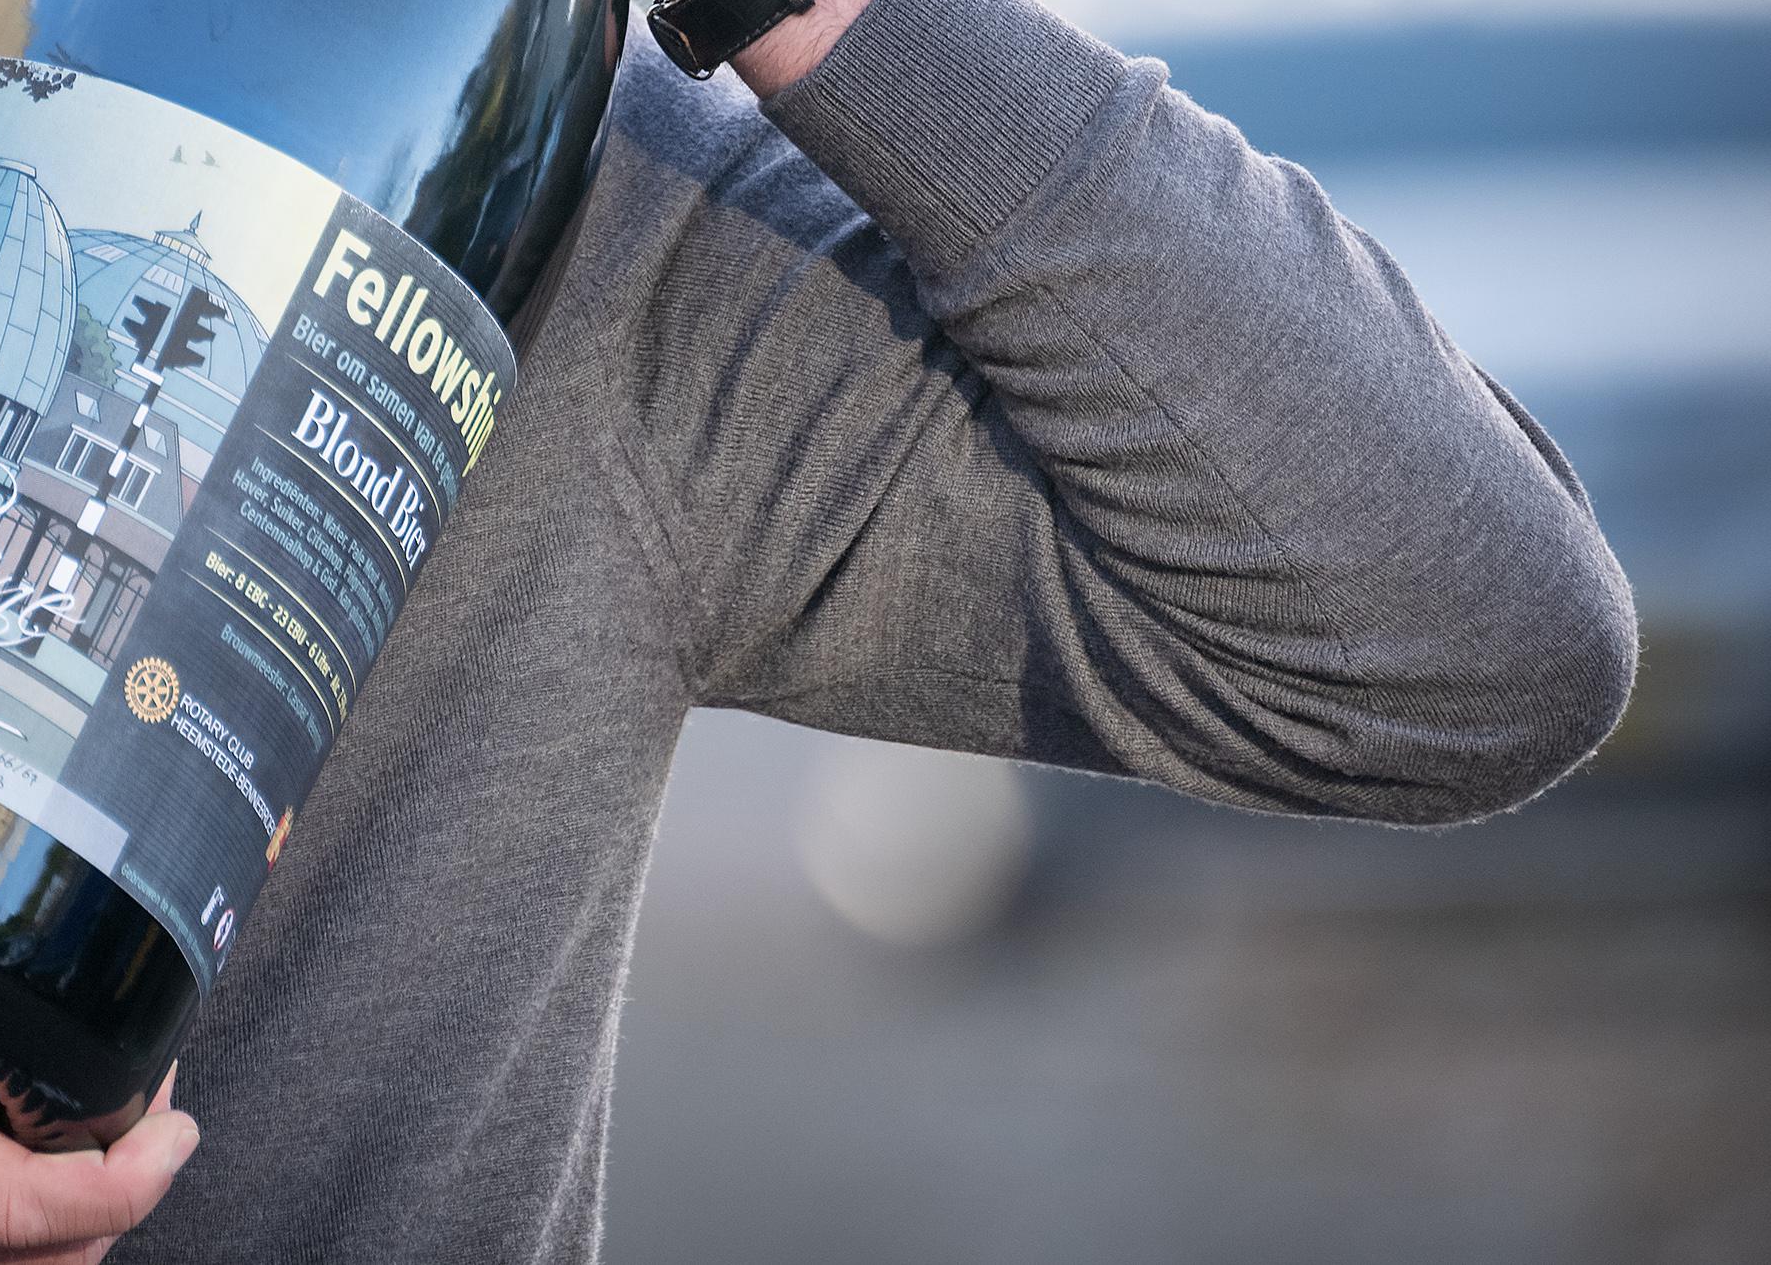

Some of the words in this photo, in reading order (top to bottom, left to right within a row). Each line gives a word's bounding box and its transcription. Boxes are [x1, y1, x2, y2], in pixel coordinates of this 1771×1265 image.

[292, 313, 337, 360] Bier
[336, 350, 367, 385] om
[366, 375, 415, 432] samen
[414, 419, 436, 457] van
[432, 441, 445, 474] te
[232, 469, 269, 507] Haver,
[270, 497, 305, 535] Suiker,
[250, 457, 323, 523] Ingrediënten:
[322, 512, 349, 549] Water,
[348, 539, 365, 567] Pale
[291, 388, 404, 518] Blond
[388, 480, 427, 571] Bier
[240, 500, 314, 570] Centennialhop
[312, 561, 323, 577] &
[320, 570, 339, 597] Gist.
[205, 551, 236, 584] Bier:
[235, 573, 247, 591] 8
[244, 580, 269, 610] EBC
[272, 605, 290, 628] 23
[286, 617, 308, 645] EBU
[308, 642, 318, 659] 6
[314, 648, 330, 678] Liter
[221, 623, 288, 696] Brouwmeester:
[179, 693, 229, 741] ROTARY
[227, 736, 255, 770] CLUB
